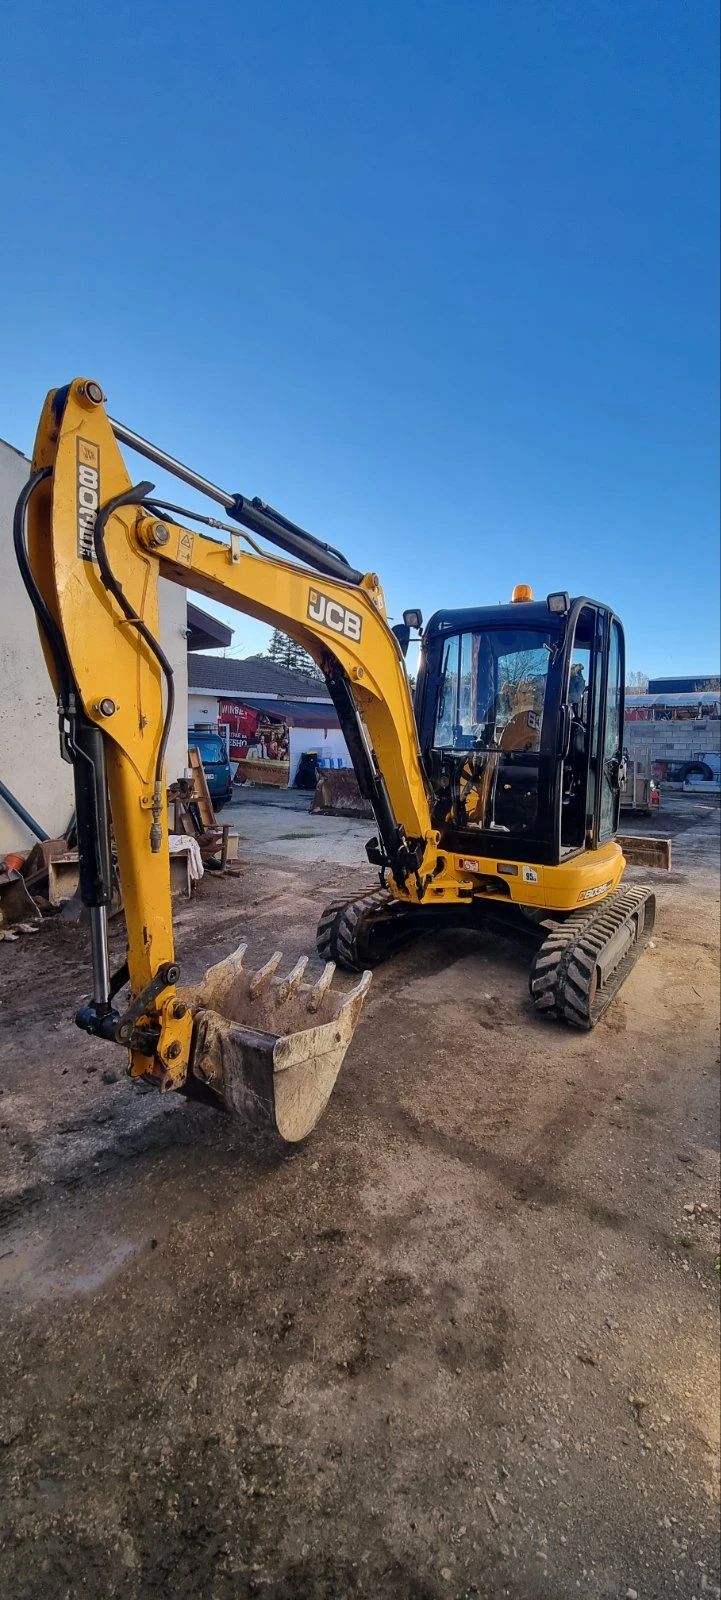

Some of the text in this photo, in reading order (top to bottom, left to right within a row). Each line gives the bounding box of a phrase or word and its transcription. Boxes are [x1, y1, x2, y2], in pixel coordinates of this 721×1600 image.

[79, 464, 99, 551] 8035
[308, 596, 361, 641] JCB
[526, 872, 534, 881] 95
